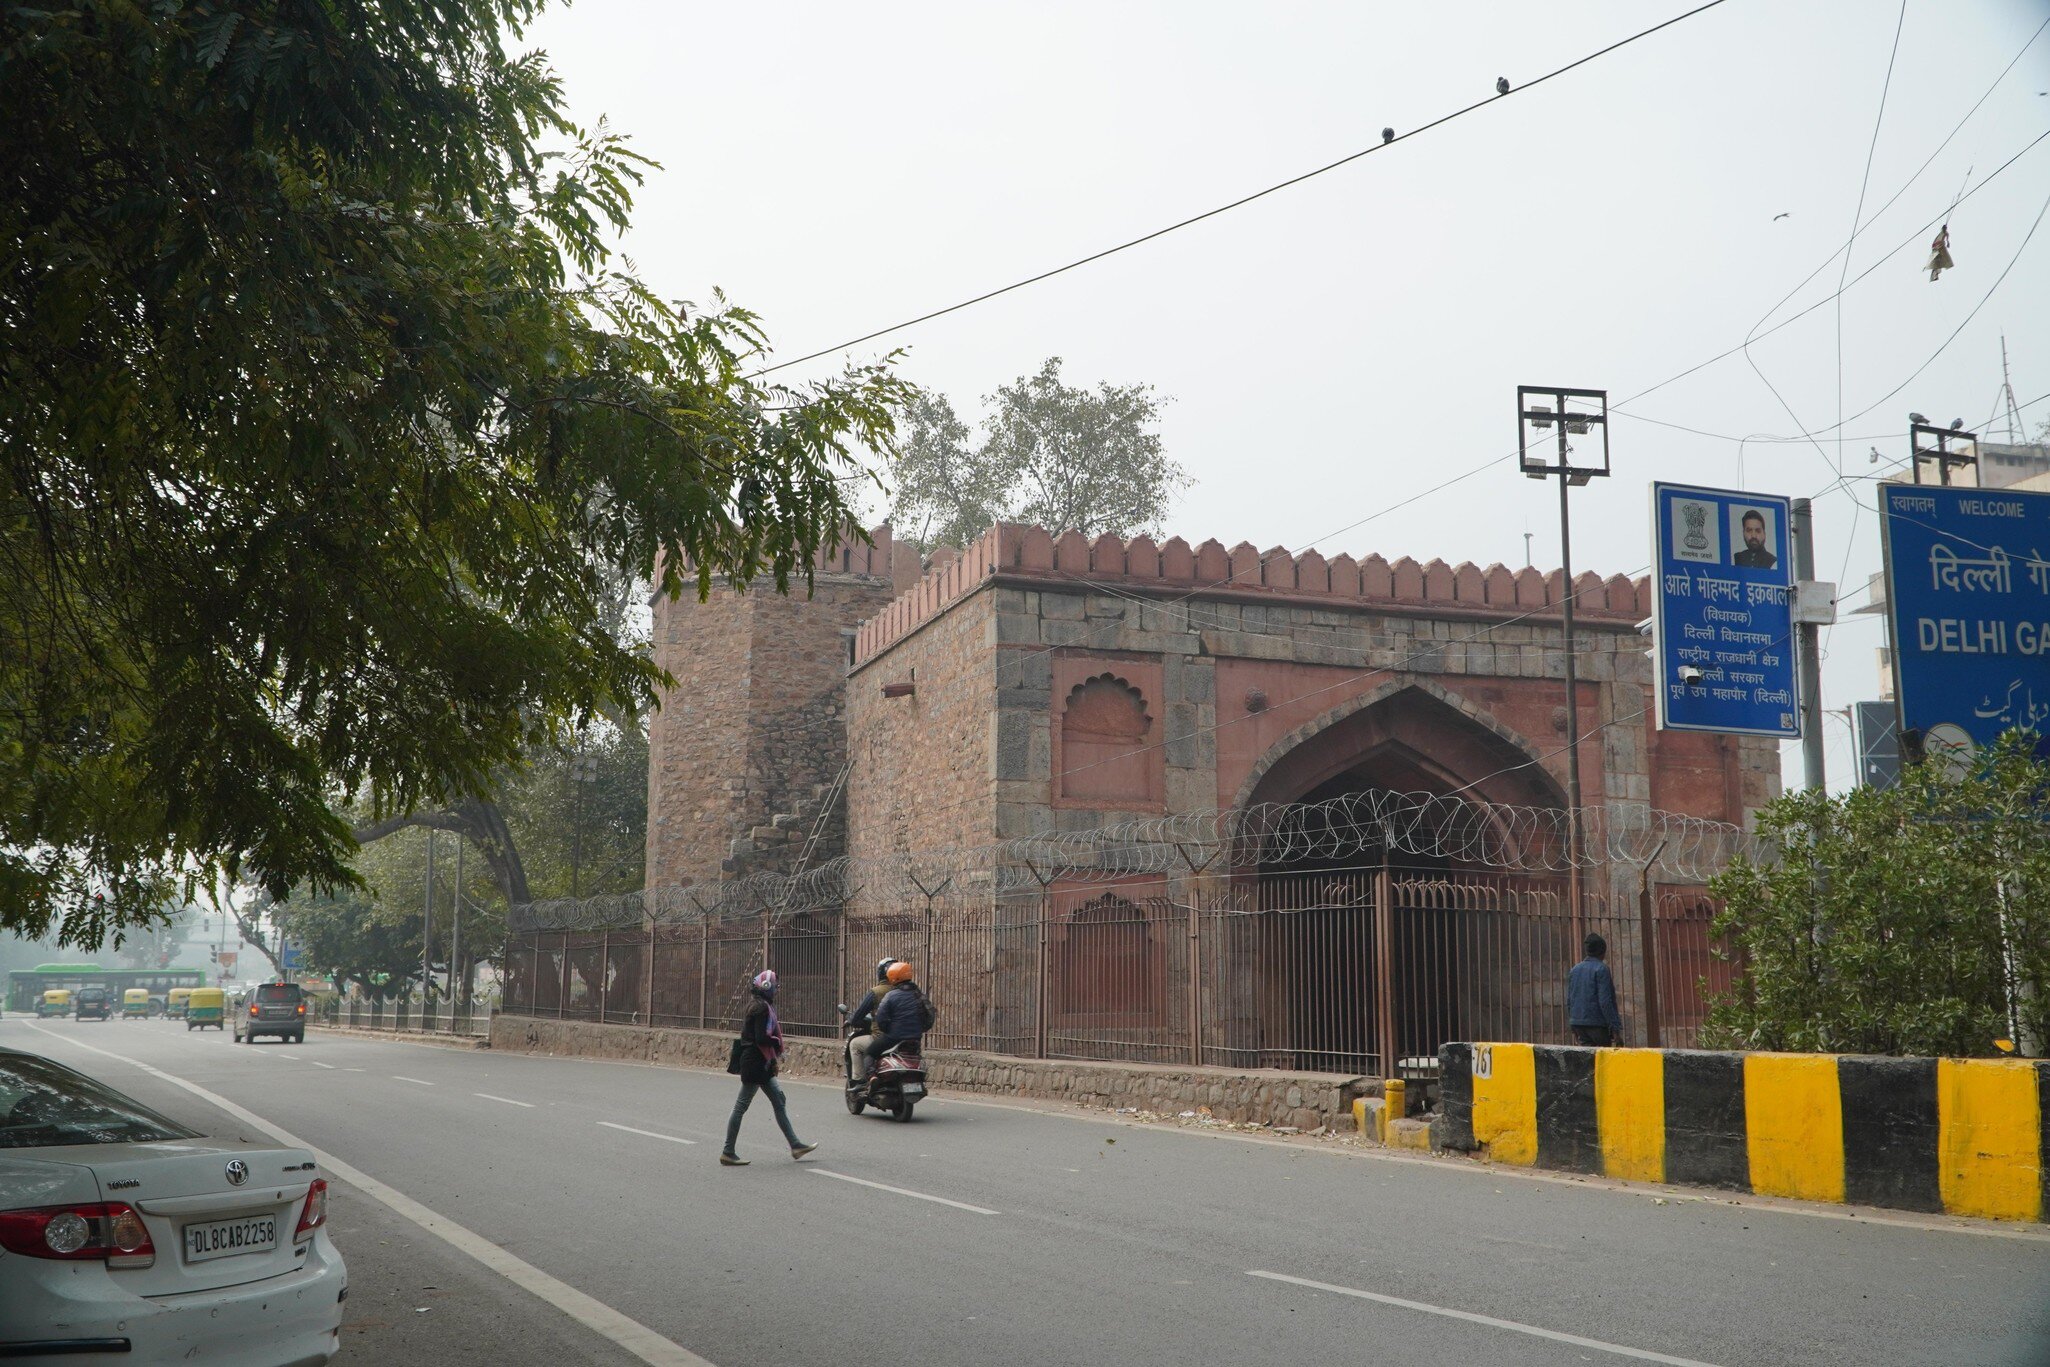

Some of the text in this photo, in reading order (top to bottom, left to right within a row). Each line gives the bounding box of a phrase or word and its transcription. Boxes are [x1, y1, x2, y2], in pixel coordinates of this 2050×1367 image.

[1891, 495, 1938, 519] स्वागतम्
[1958, 499, 2025, 518] WELCOME
[1929, 543, 2012, 594] दिल्ली
[1665, 567, 1691, 597] आले
[1697, 569, 1741, 602] मोहम्मद
[1703, 605, 1752, 627] (विधायक)
[1684, 623, 1772, 645] दिल्ली विधानसभा
[1918, 617, 2007, 654] DELHI
[1677, 645, 1779, 667] राष्ट्रीय राजधानी क्षेत्र
[1729, 671, 1765, 685] सरकार
[1671, 681, 1792, 708] पूर्व उप महापौर (दिल्ली)
[107, 1178, 140, 1190] TOYOTA
[194, 1221, 274, 1254] DL8CAB2258
